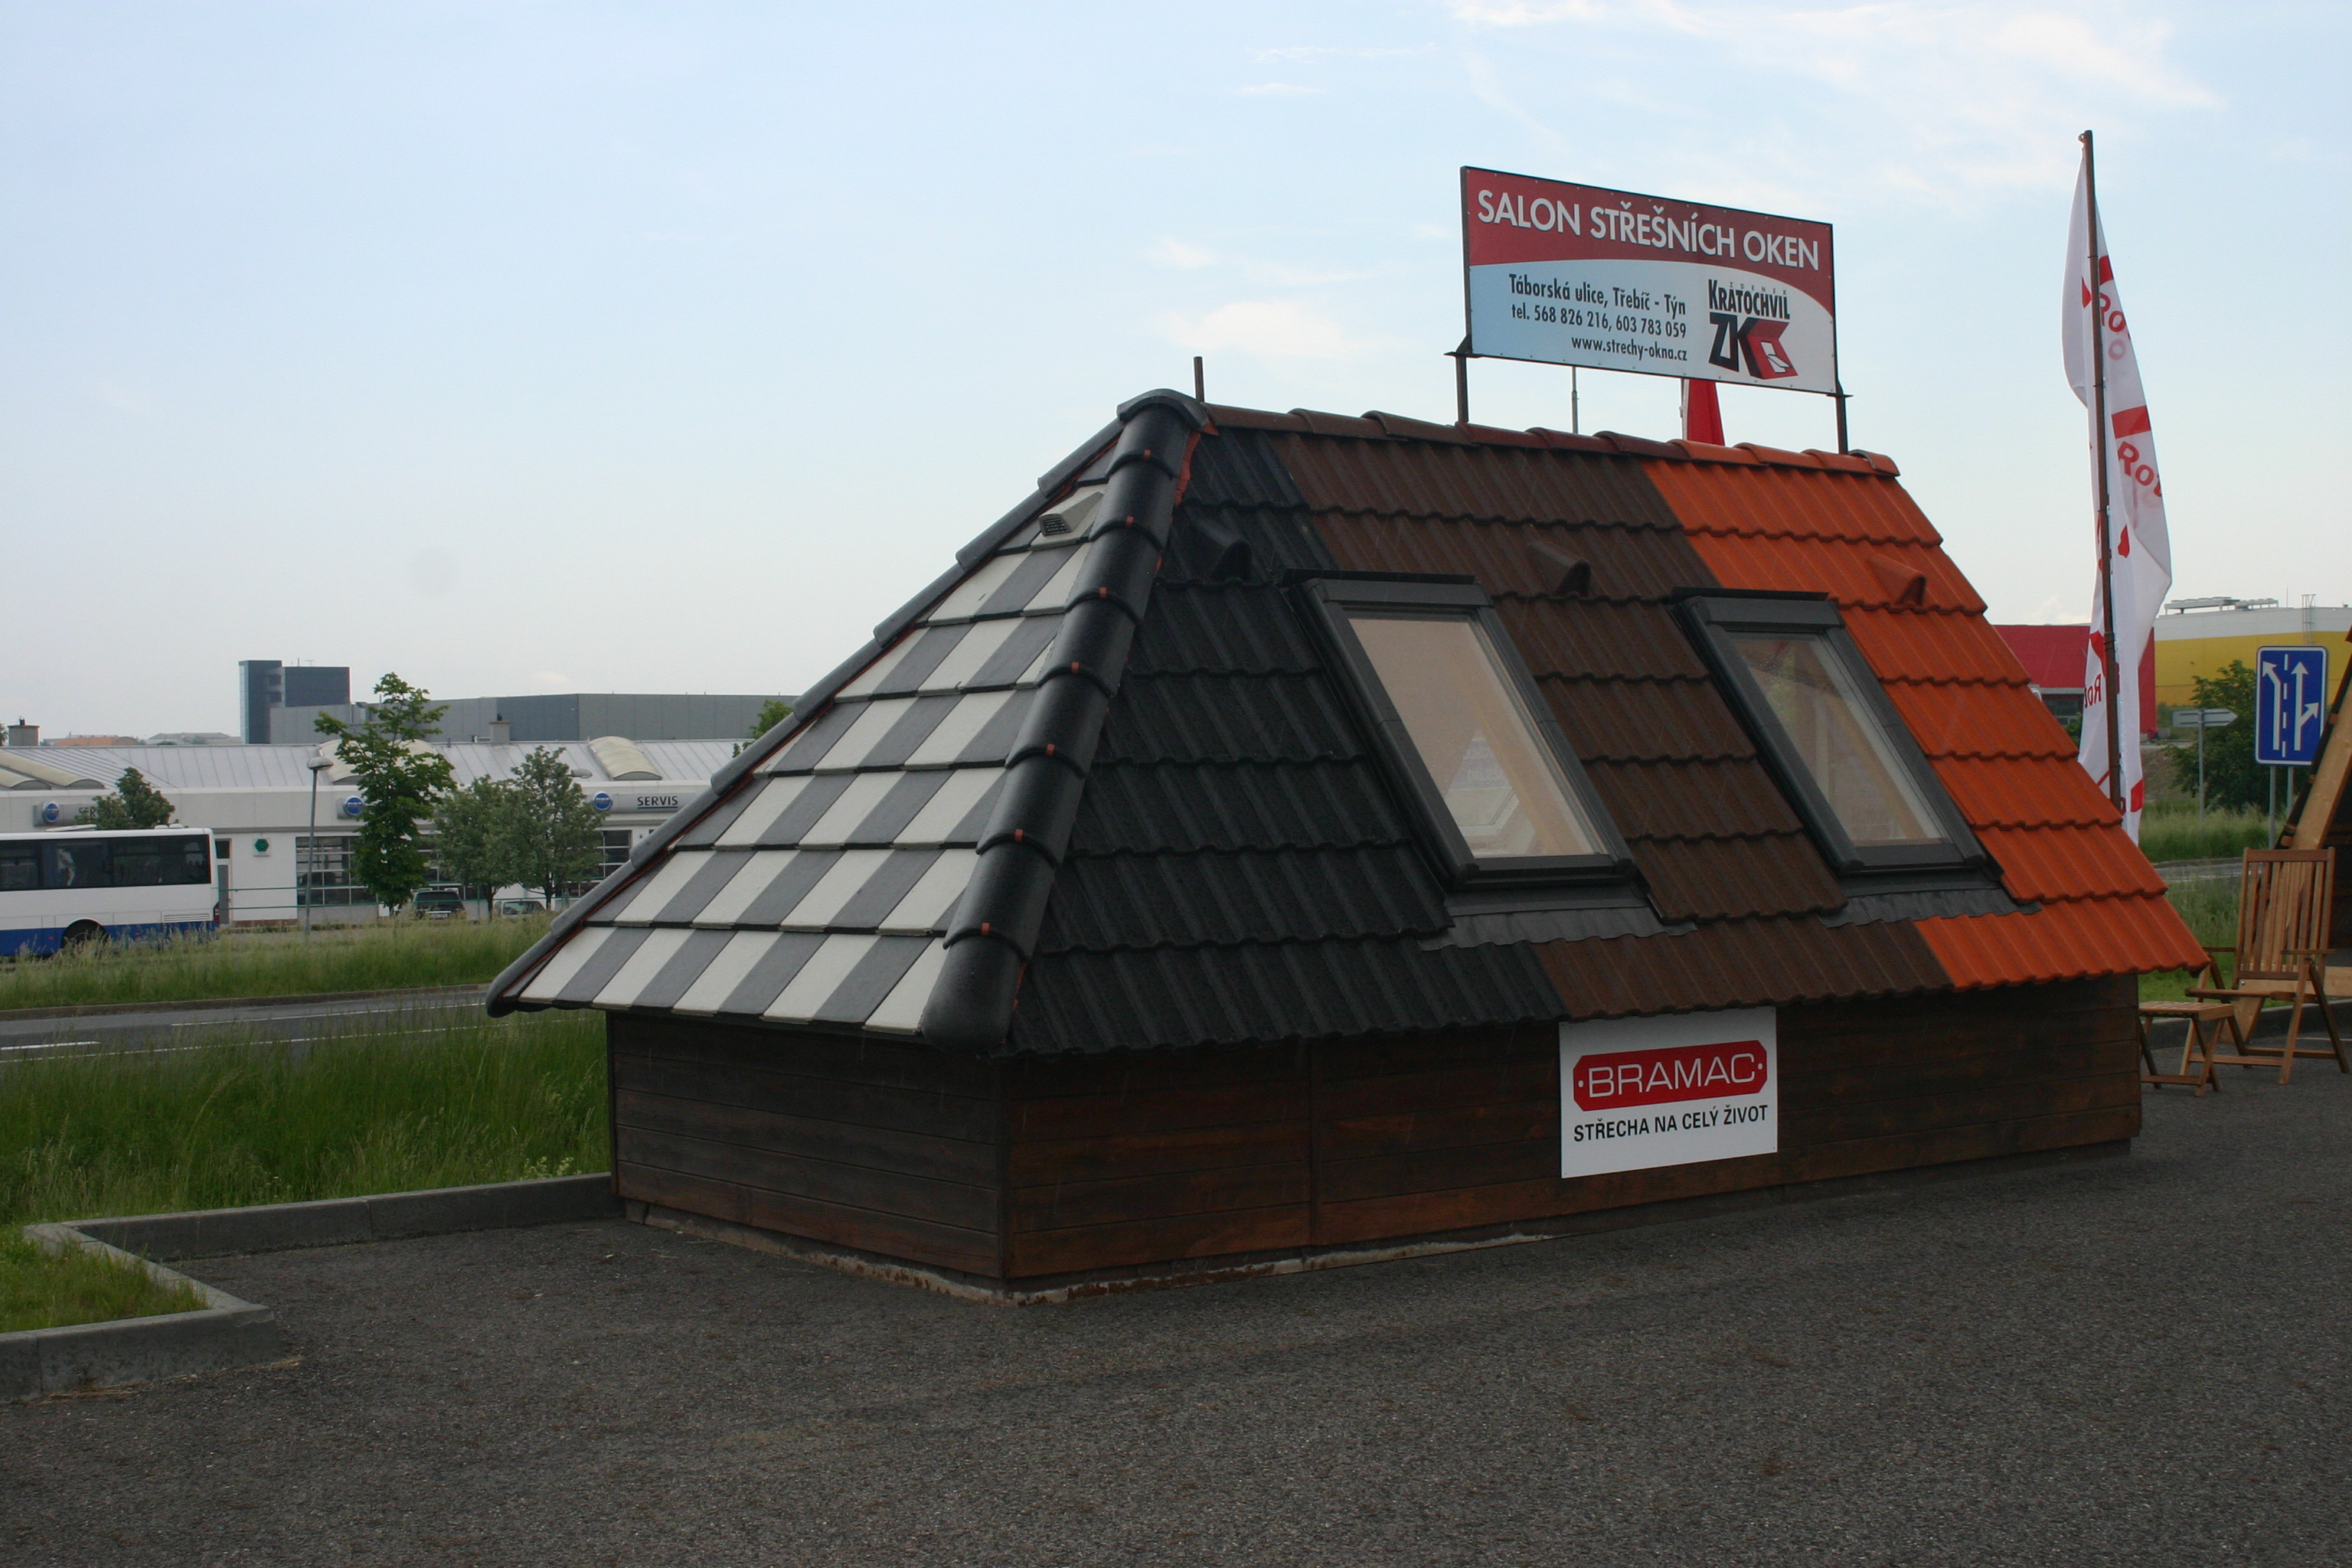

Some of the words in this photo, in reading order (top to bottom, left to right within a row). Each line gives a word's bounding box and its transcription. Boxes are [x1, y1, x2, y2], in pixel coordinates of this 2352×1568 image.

[1478, 189, 1580, 236] SALON
[1590, 200, 1735, 258] STŘEŠNÍCH
[1743, 230, 1818, 270] OKEN
[1508, 273, 1570, 300] Táborská
[1576, 282, 1608, 308] ulice,
[1612, 287, 1650, 311] Třebíč
[1664, 294, 1686, 320] Týn
[1511, 302, 1530, 320] tel.
[1534, 305, 1557, 323] 568
[1560, 308, 1583, 325] 826
[1587, 311, 1612, 332] 216,
[1616, 315, 1637, 332] 603
[1641, 318, 1661, 335] 783
[1665, 321, 1687, 338] 059
[1571, 337, 1687, 361] www.strechy-okna.cz
[637, 796, 678, 806] SERVIS
[1588, 1052, 1756, 1098] BRAMAC
[1573, 1118, 1650, 1142] STŘECHA
[1655, 1115, 1677, 1133] NA
[1682, 1106, 1719, 1129] CELÝ
[1723, 1104, 1768, 1125] ŽIVOT
